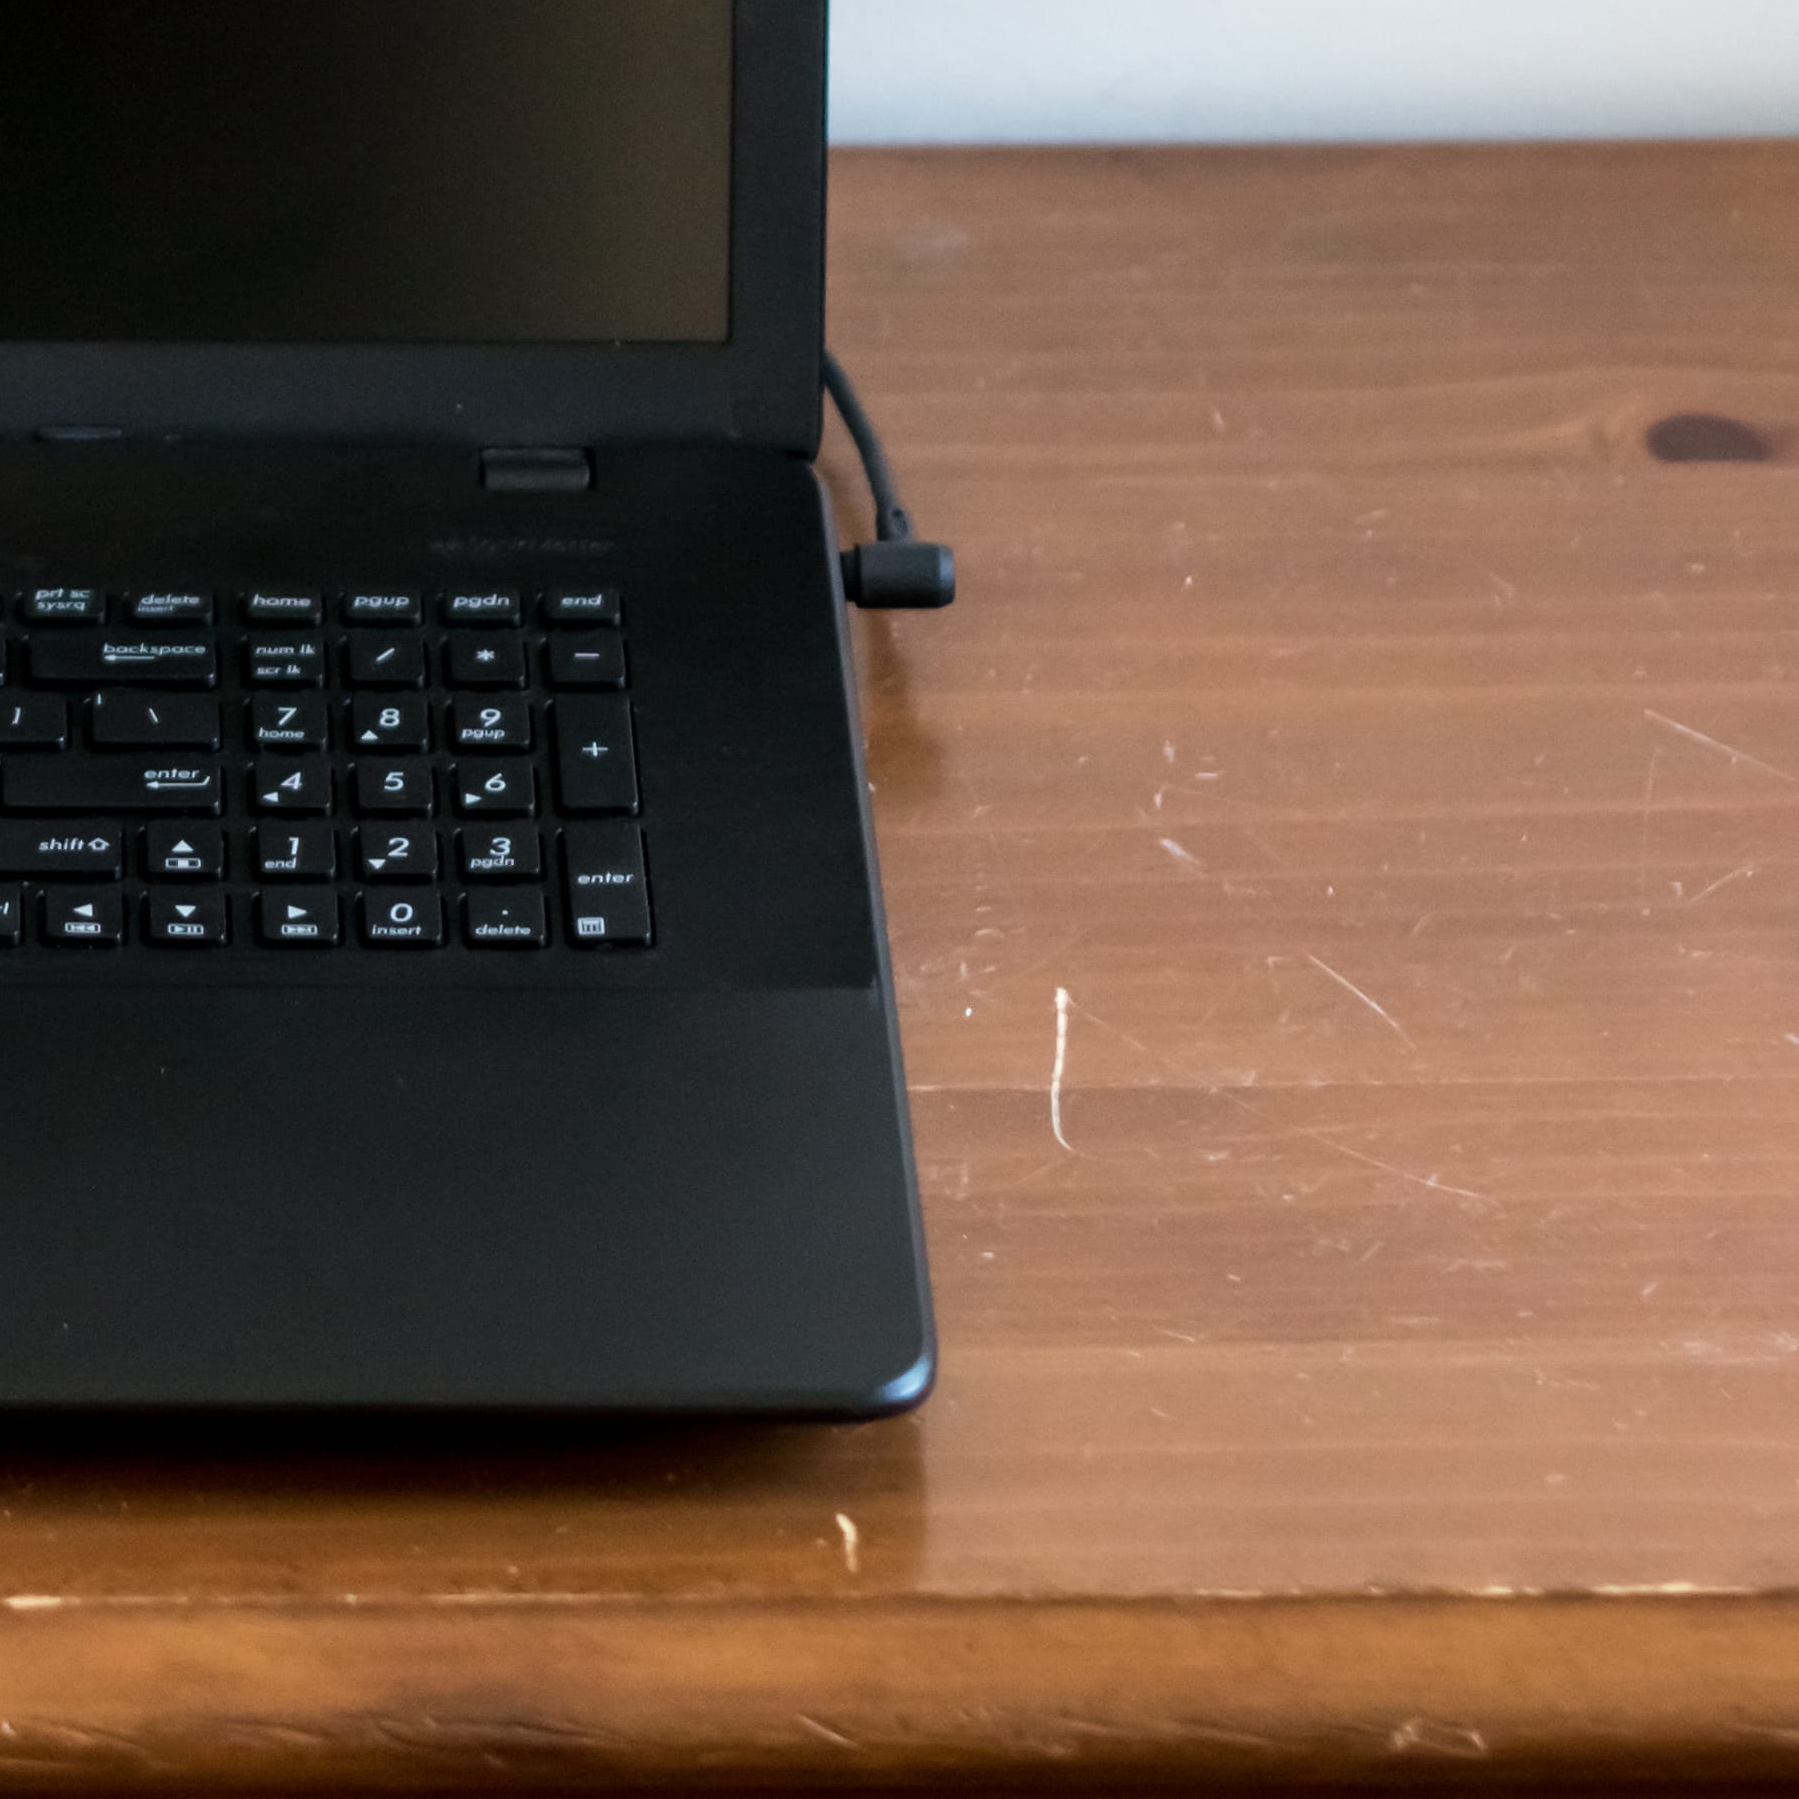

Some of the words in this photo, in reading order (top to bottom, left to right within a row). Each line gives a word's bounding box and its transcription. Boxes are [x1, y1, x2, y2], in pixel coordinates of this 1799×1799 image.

[34, 588, 64, 601] prt
[69, 589, 90, 599] sc
[139, 593, 201, 605] delete
[252, 593, 312, 608] home
[452, 593, 510, 610] pgdn
[561, 594, 603, 607] end
[35, 599, 87, 612] sysrq
[353, 596, 410, 609] pgup
[102, 642, 206, 655] backspace
[255, 646, 295, 656] num
[299, 644, 315, 655] lk
[256, 666, 281, 676] scr
[286, 664, 301, 675] lk
[278, 706, 297, 726] 7
[379, 708, 401, 728] 8
[479, 708, 502, 728] 9
[258, 727, 305, 740] home
[462, 728, 506, 740] pgup
[143, 768, 200, 782] enter
[280, 771, 302, 791] 4
[383, 771, 404, 792] 5
[484, 772, 507, 793] 6
[38, 837, 85, 851] shift
[289, 837, 300, 856] 1
[387, 837, 410, 858] 2
[489, 836, 513, 857] 3
[264, 856, 298, 870] end
[469, 857, 515, 869] pgdn
[577, 872, 634, 885] enter
[389, 902, 414, 923] 0
[371, 924, 422, 936] insert
[474, 923, 531, 936] delete
